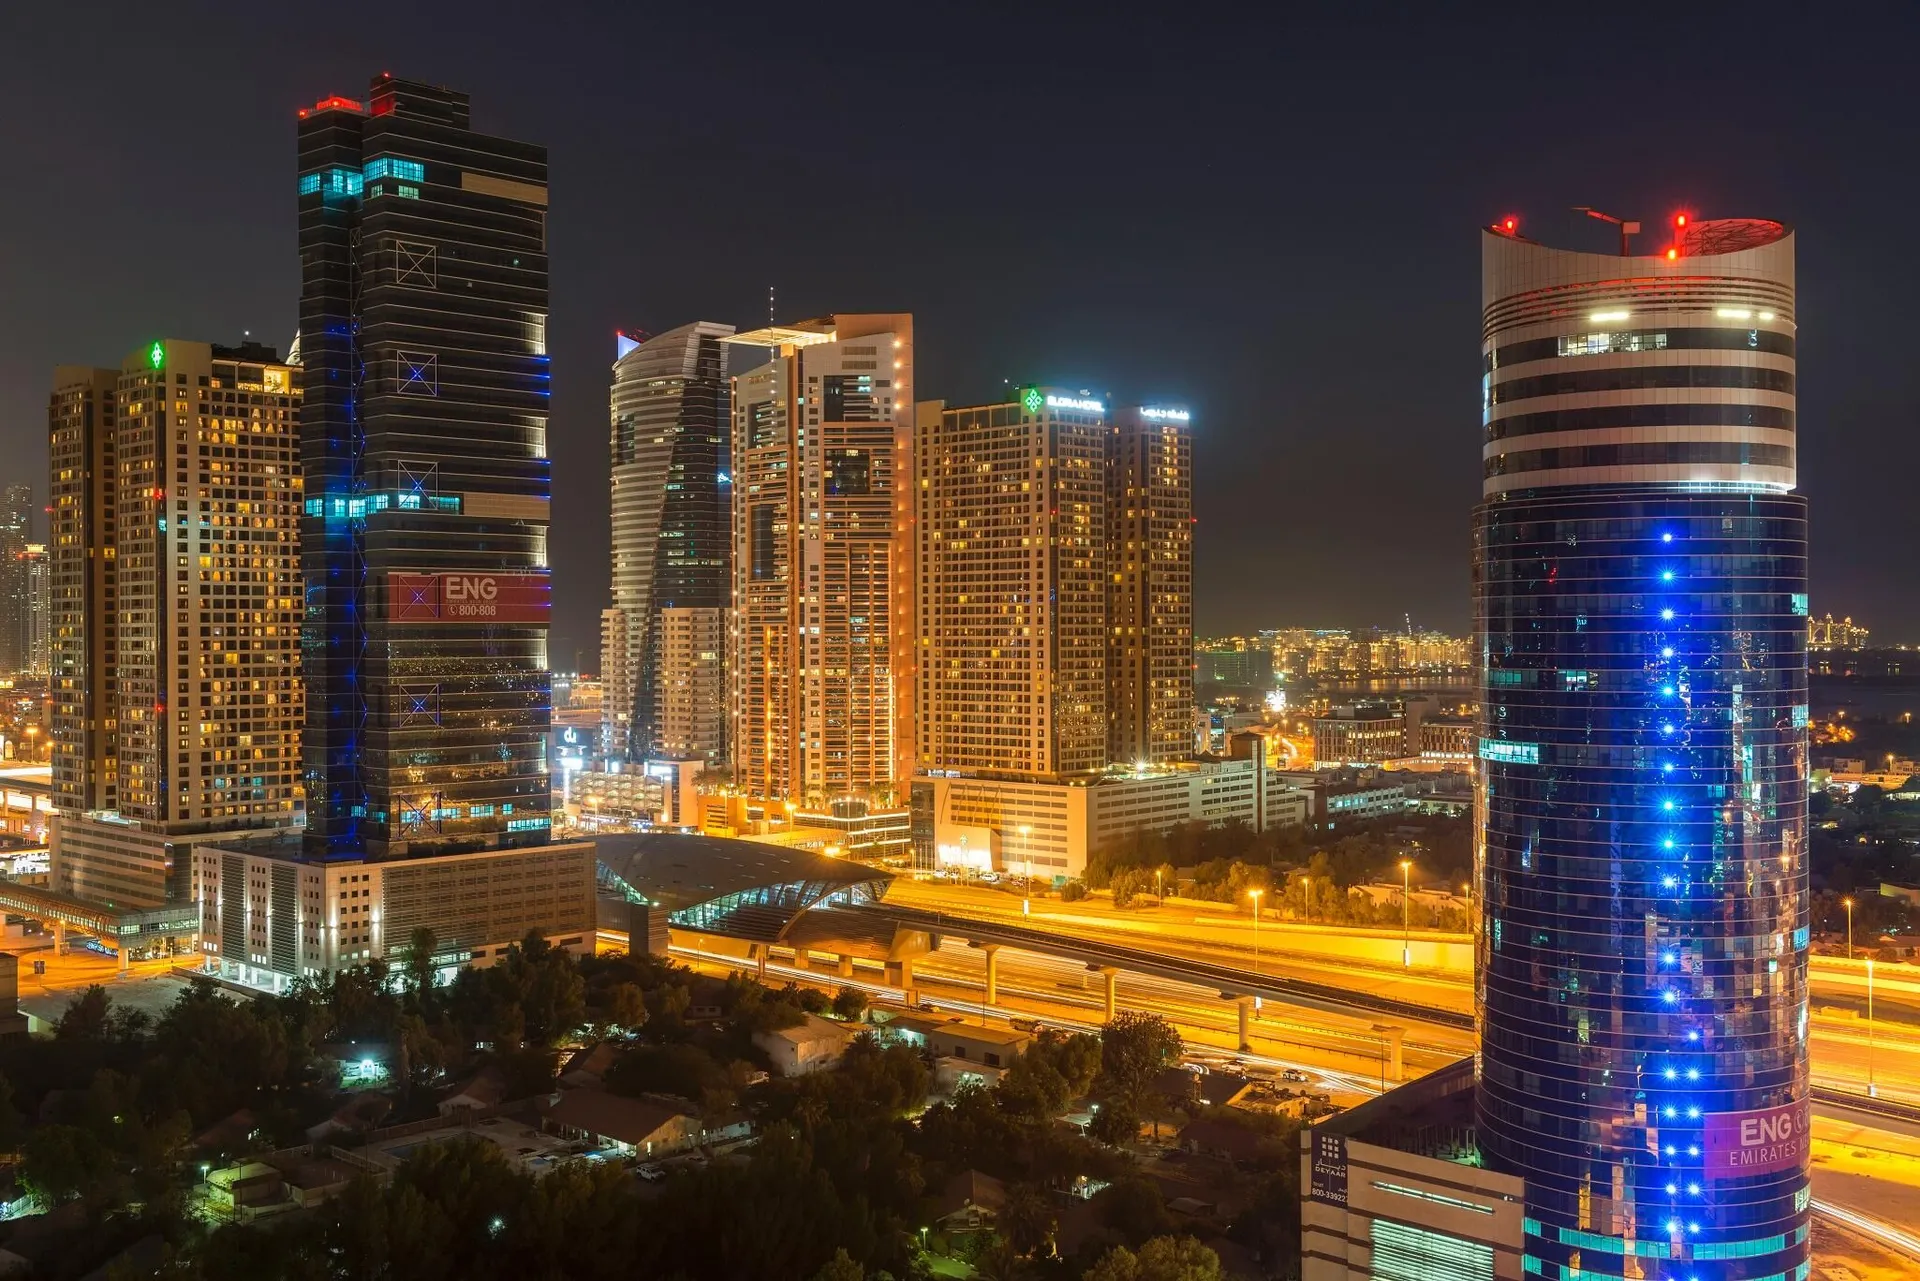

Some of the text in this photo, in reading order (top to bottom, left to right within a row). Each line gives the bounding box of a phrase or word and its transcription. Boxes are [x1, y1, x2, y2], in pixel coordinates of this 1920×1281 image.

[446, 577, 498, 600] ENG
[459, 605, 496, 616] 800-808
[564, 726, 577, 743] du
[1740, 1112, 1792, 1146] ENG
[1730, 1140, 1797, 1166] EMIRATES
[1315, 1166, 1346, 1178] DEYAAR
